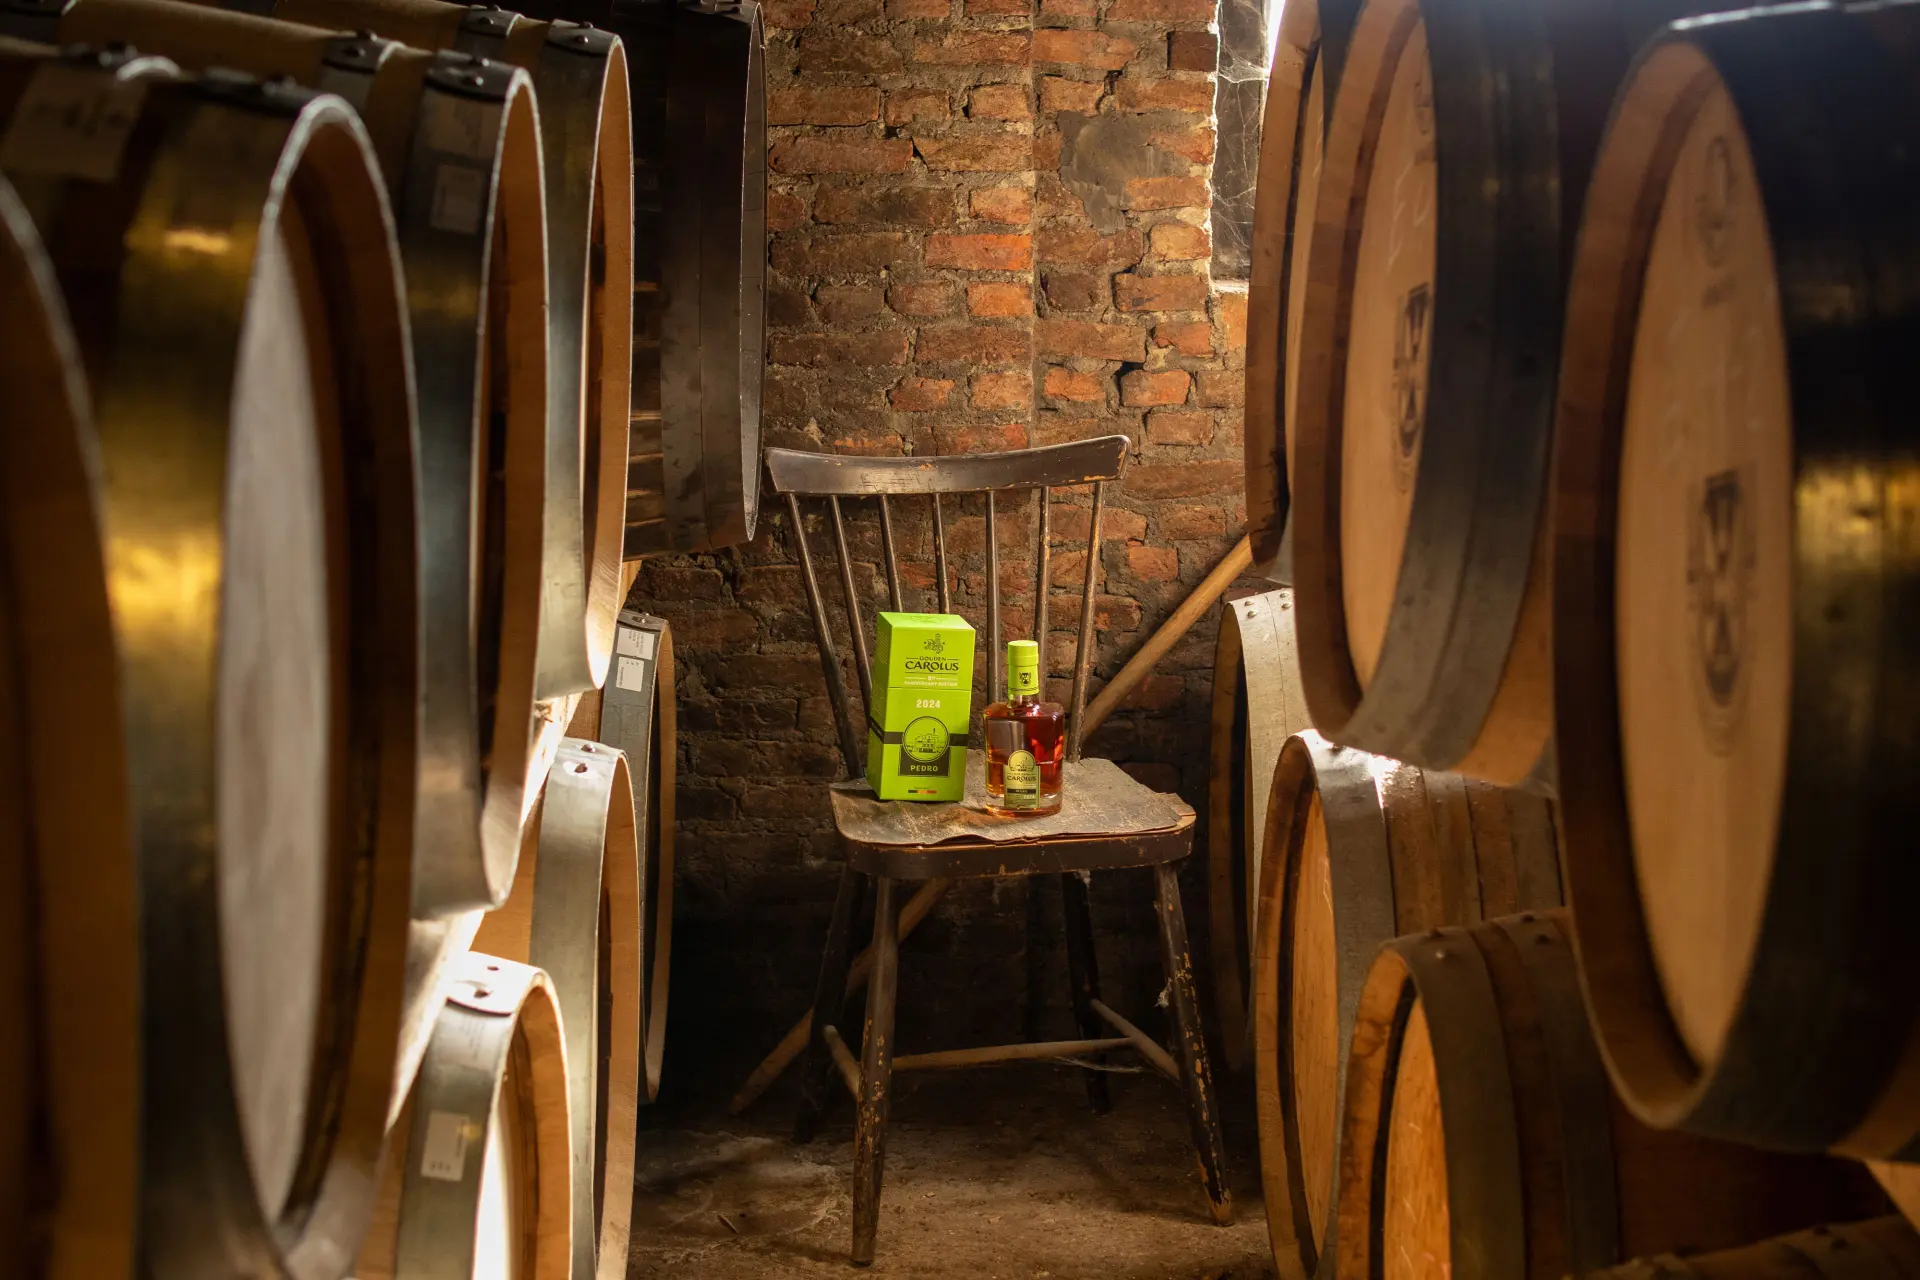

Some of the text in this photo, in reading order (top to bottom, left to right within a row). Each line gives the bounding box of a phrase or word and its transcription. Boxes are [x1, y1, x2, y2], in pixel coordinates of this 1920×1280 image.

[905, 661, 959, 672] CAROLUS
[916, 699, 941, 709] 2024
[910, 764, 939, 772] PEDRO
